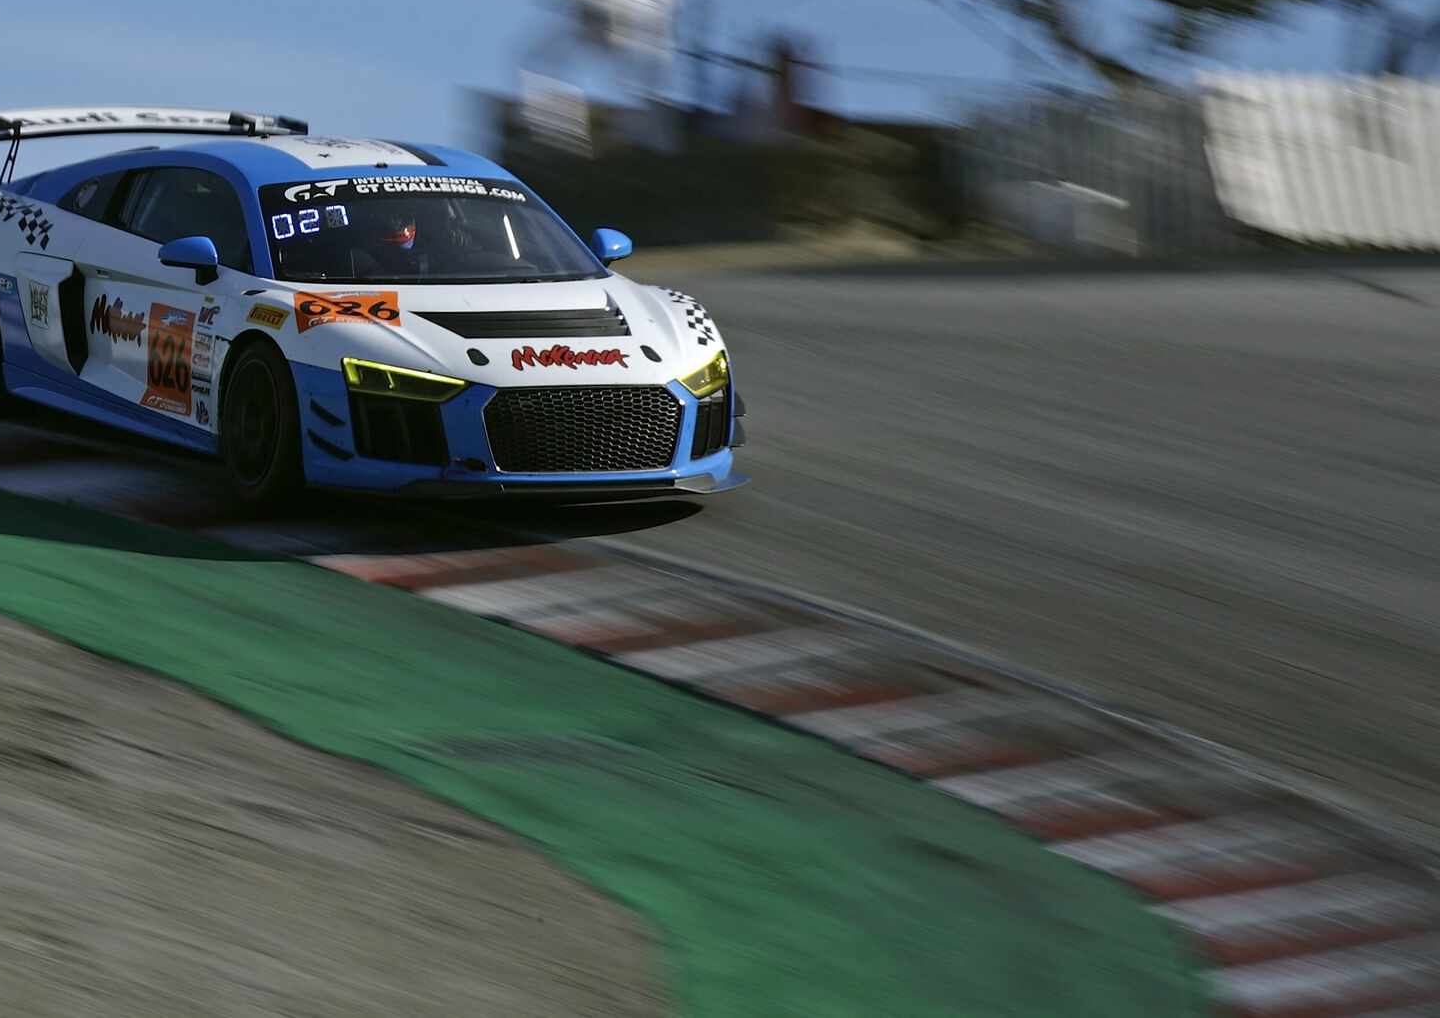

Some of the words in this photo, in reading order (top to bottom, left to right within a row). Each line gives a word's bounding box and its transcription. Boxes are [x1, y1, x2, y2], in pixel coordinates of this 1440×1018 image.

[19, 112, 121, 127] Audi
[136, 112, 230, 124] Spo
[352, 176, 483, 186] INTERCONTINENTAL
[356, 183, 379, 194] GT
[384, 183, 526, 203] CHALLENGE.COM
[250, 307, 284, 325] PIRELLI
[299, 300, 400, 321] 626
[149, 330, 189, 394] 626
